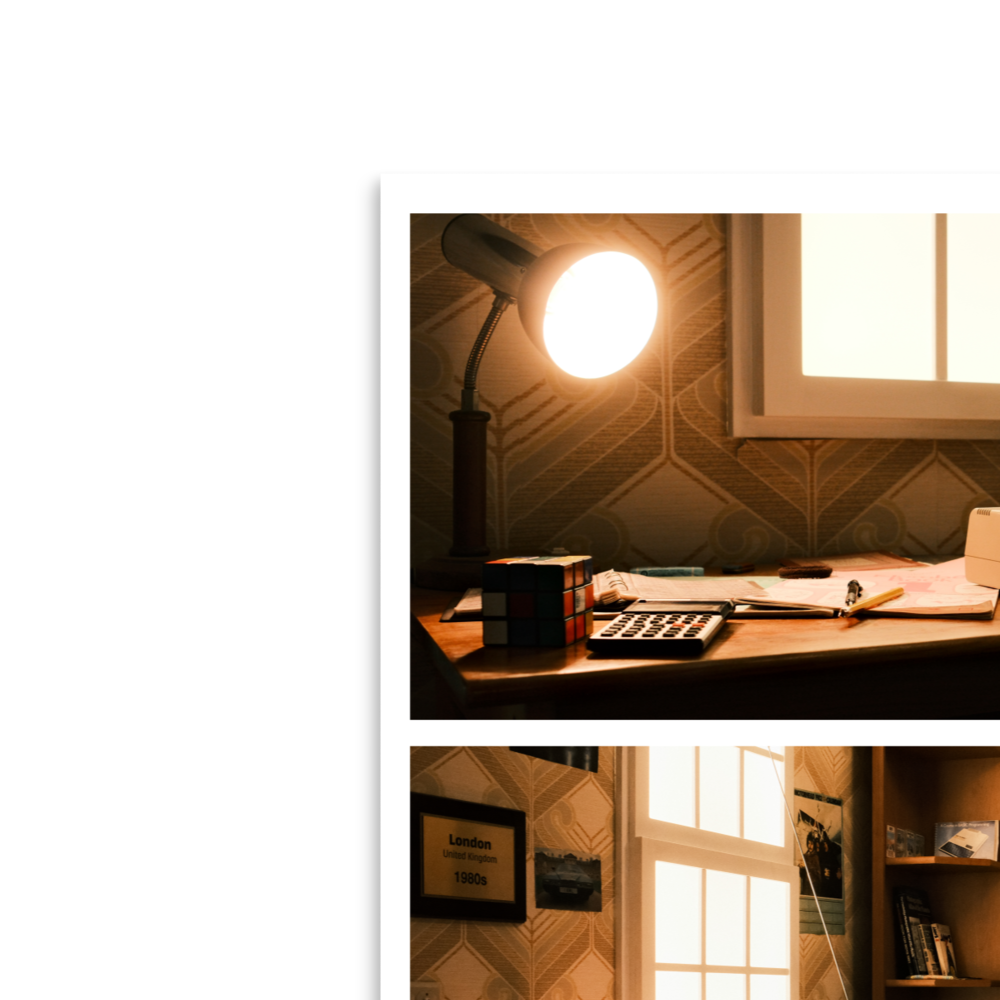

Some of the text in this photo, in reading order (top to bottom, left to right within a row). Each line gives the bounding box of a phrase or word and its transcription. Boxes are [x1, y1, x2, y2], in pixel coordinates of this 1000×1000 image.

[449, 834, 492, 850] London
[443, 849, 498, 864] United Kingdom
[454, 871, 487, 886] 1980s
